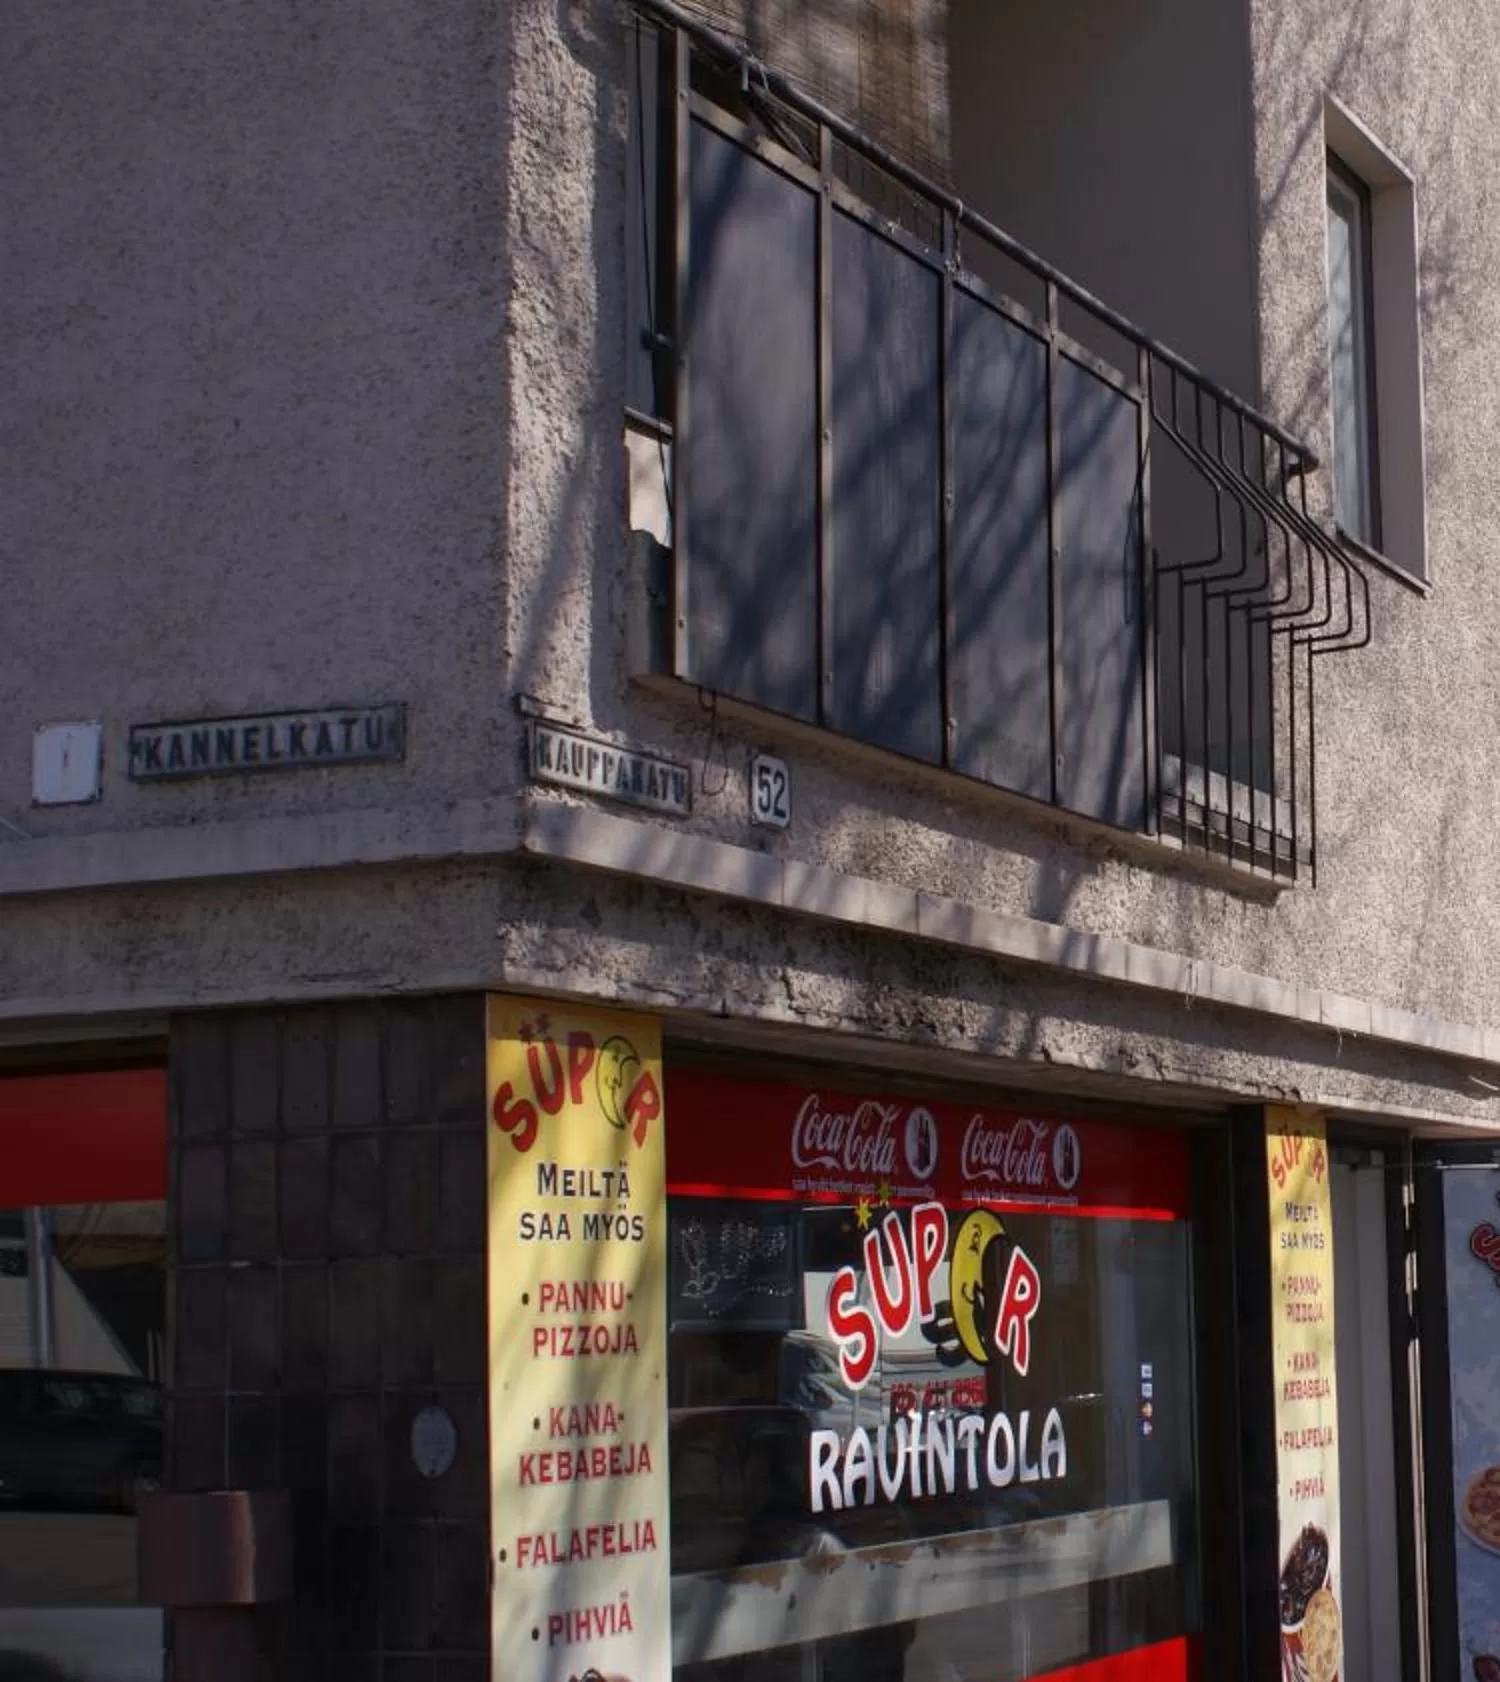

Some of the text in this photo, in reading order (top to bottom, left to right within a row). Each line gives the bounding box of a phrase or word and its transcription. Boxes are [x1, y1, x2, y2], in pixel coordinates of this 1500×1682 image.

[145, 714, 383, 770] KANNELKATU
[536, 731, 687, 804] KAUPPAKATU
[758, 764, 787, 818] 52
[537, 1162, 631, 1199] MEILTÄ
[520, 1203, 645, 1241] SAA MYÖS
[539, 1280, 633, 1313] PANNU-
[533, 1323, 640, 1358] PIZZOJA
[550, 1403, 625, 1438] KANA-
[519, 1443, 653, 1487] KEBABEJA
[810, 1407, 1067, 1514] RAVINTOLA
[516, 1519, 657, 1570] FALAFELIA
[548, 1590, 634, 1647] PIHVIÄ
